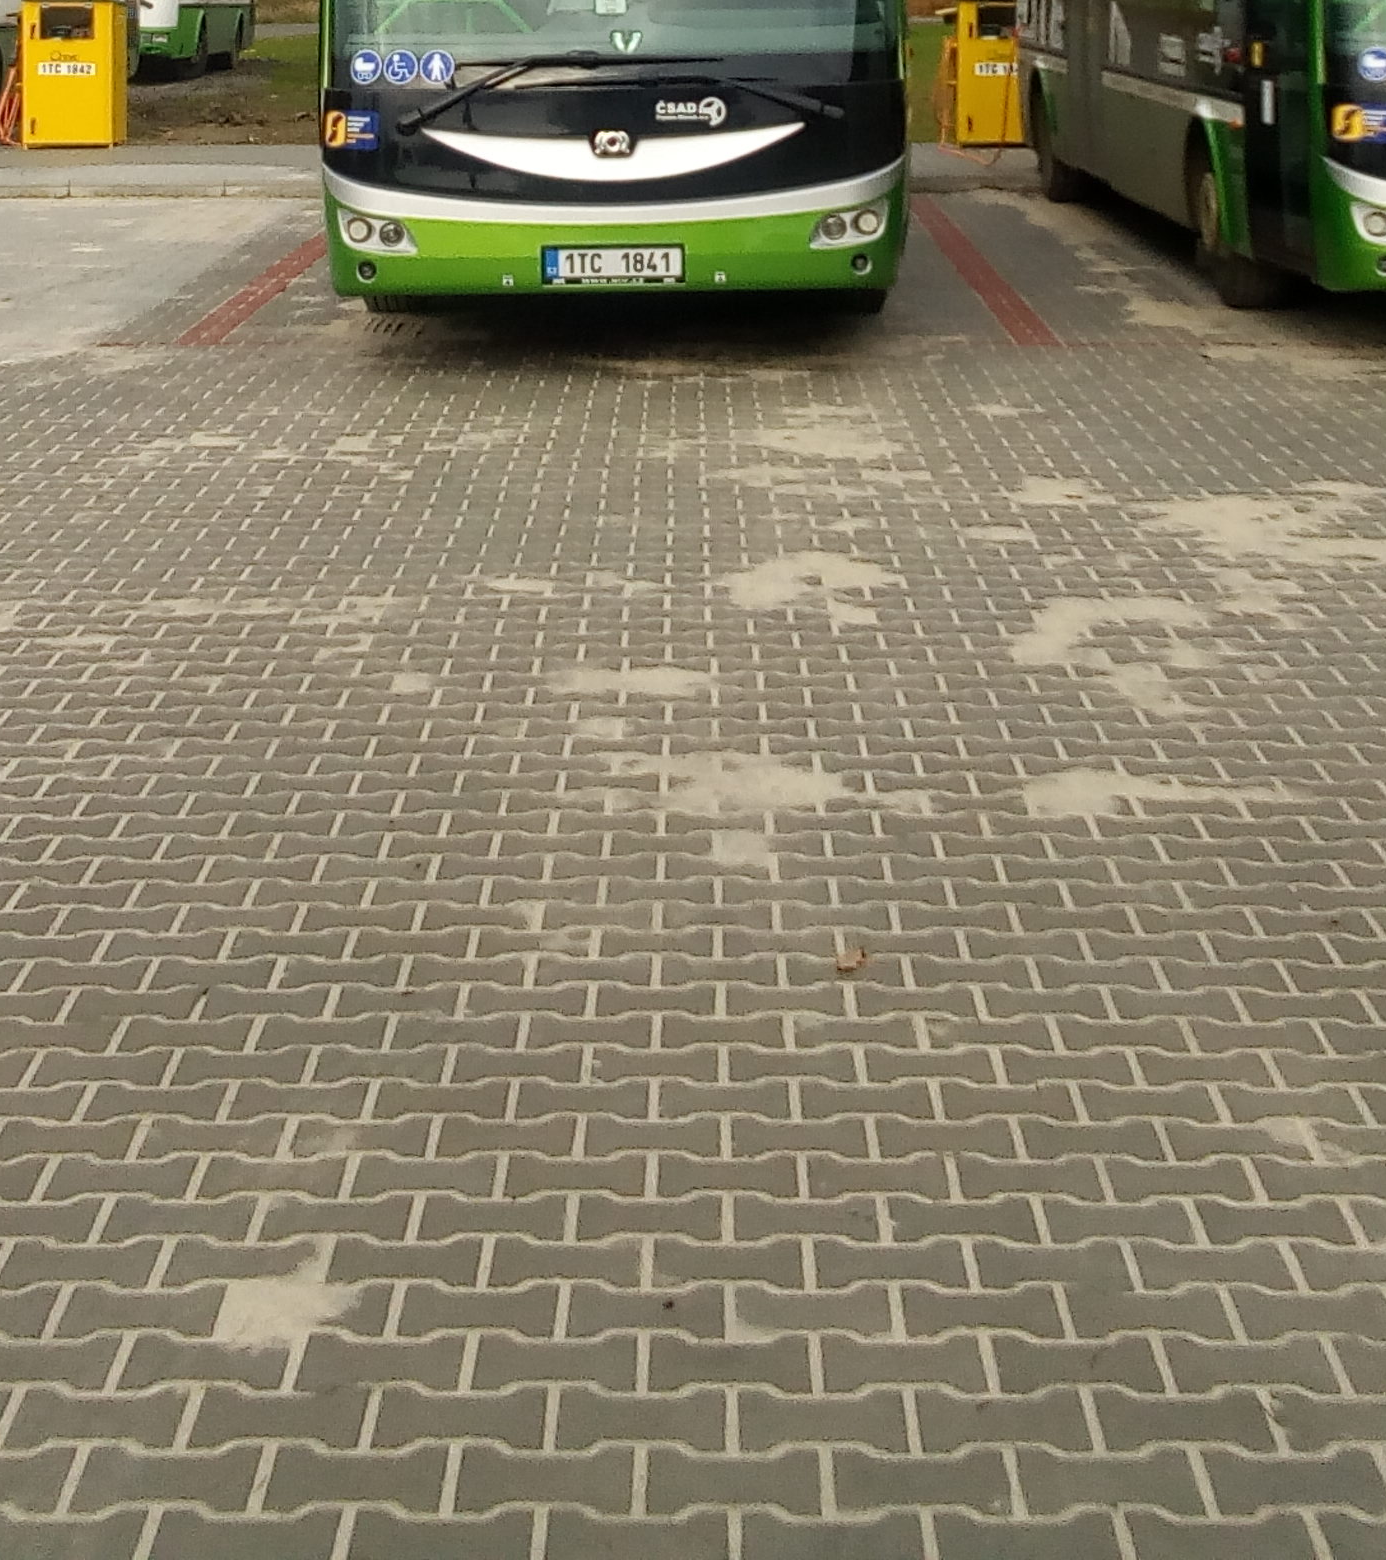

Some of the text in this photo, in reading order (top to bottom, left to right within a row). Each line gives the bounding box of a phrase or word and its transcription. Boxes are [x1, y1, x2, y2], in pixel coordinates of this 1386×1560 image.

[42, 63, 61, 74] 1TC
[655, 100, 697, 114] ČSAD
[565, 251, 671, 274] 1TC 1841
